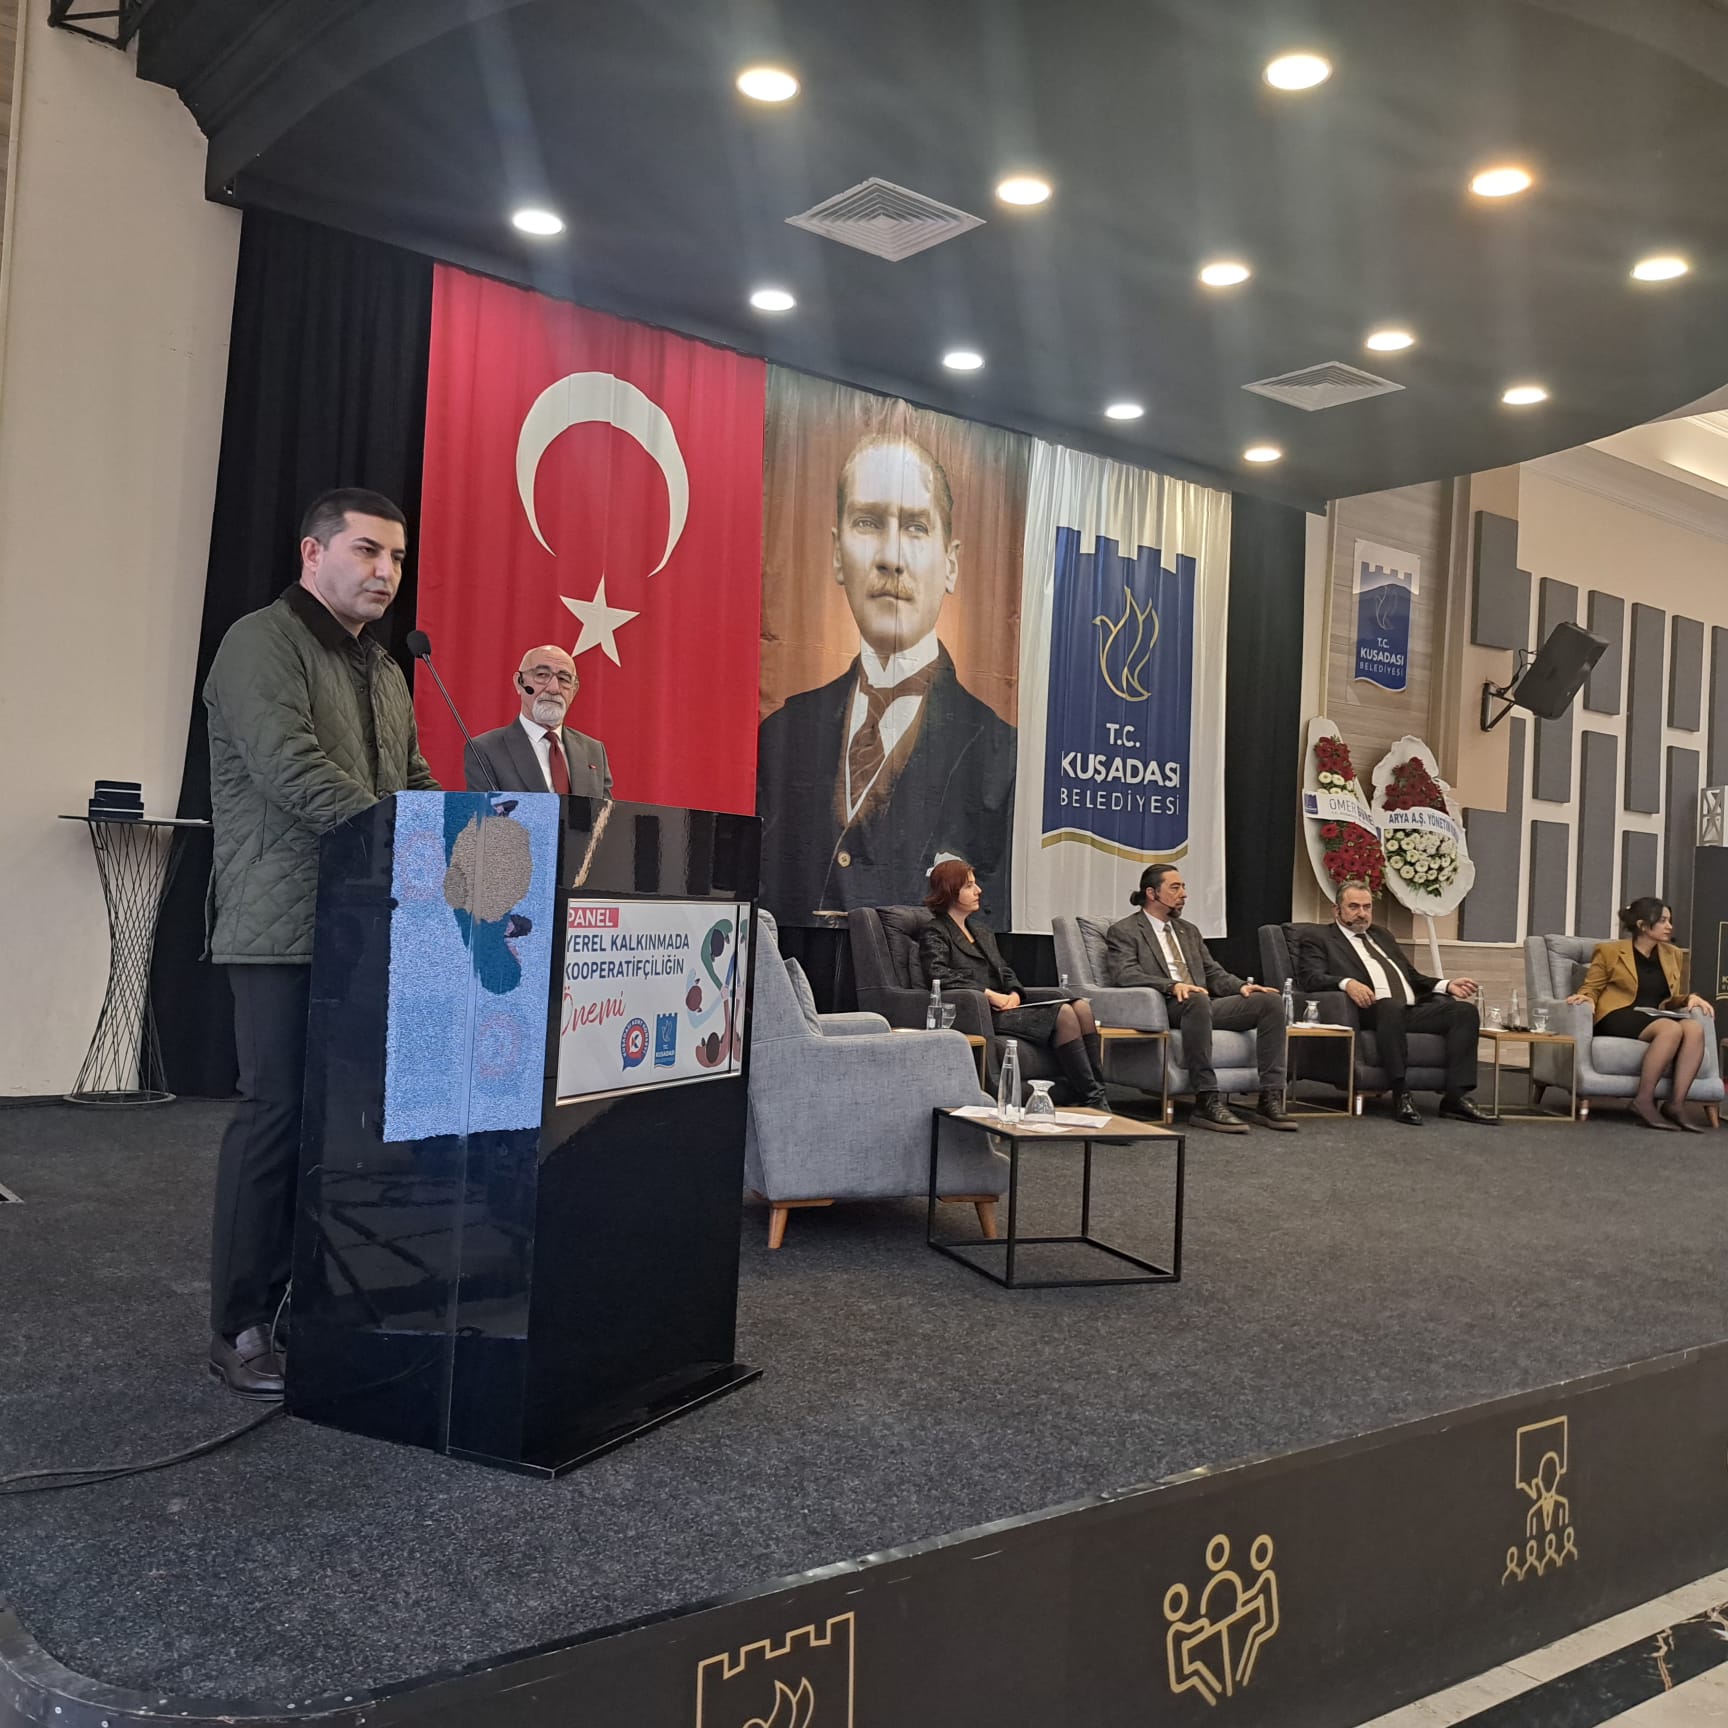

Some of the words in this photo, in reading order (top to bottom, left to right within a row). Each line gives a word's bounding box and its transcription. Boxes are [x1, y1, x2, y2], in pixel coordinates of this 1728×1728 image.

[1106, 723, 1140, 748] T.C.
[1061, 751, 1180, 788] KUŞADASI
[1060, 787, 1179, 815] BELEDİYESİ
[1389, 812, 1410, 825] ARYA
[1411, 811, 1427, 826] A.Ş.
[611, 933, 690, 951] KALKINMADA
